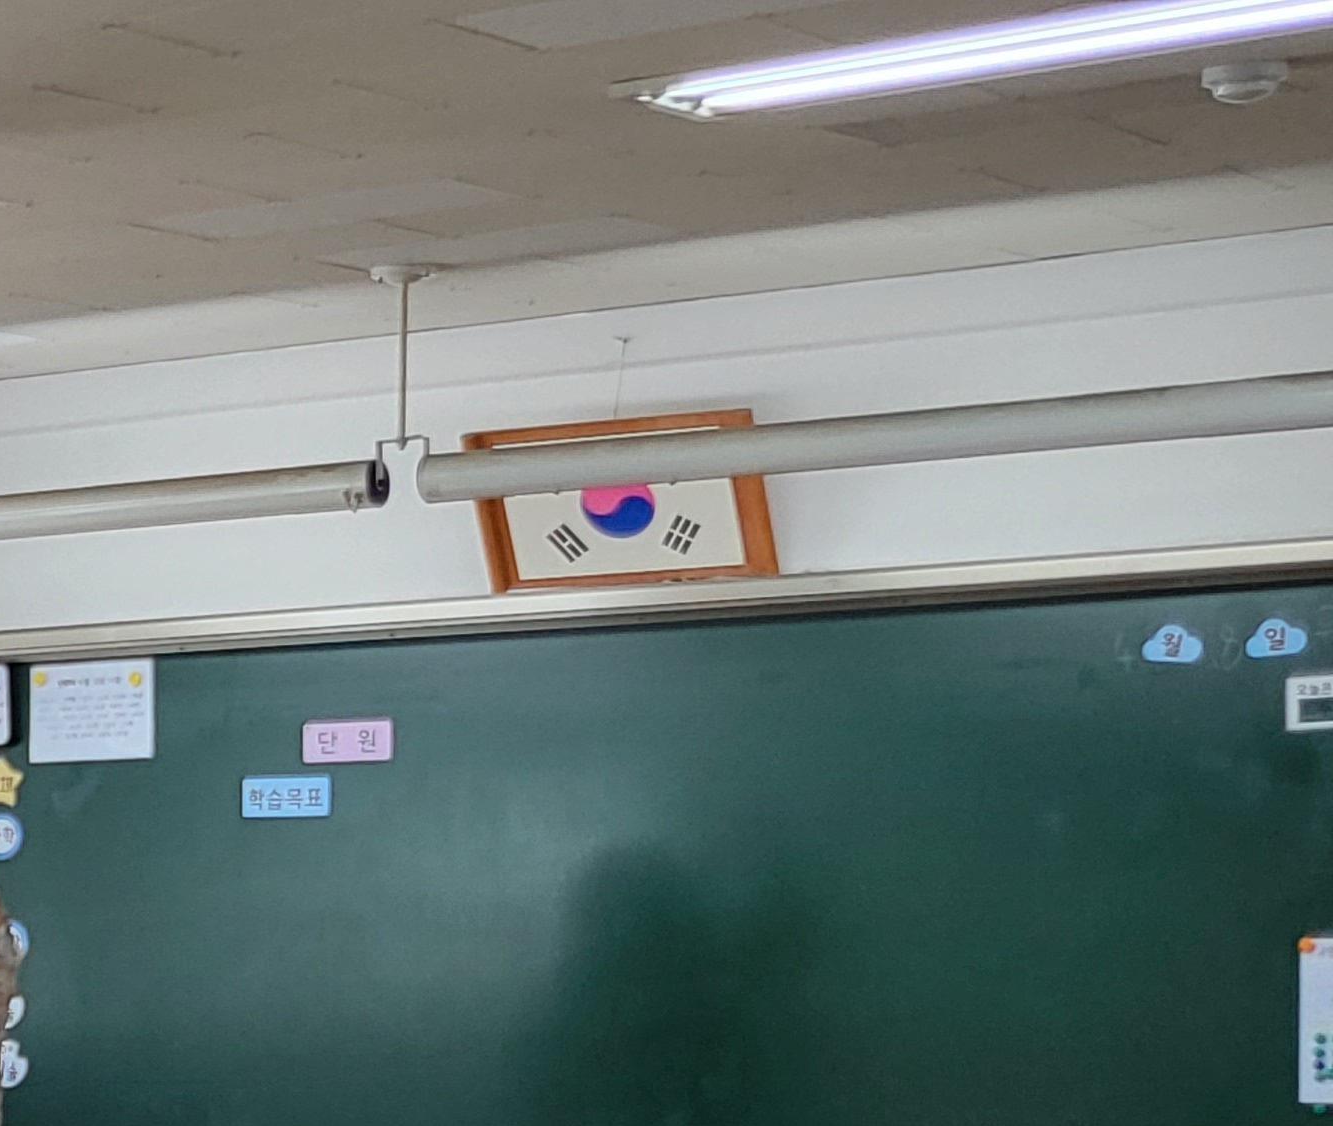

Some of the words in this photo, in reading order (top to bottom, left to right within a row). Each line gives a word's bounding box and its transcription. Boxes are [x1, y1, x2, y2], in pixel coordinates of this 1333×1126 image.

[1161, 632, 1183, 658] 월
[1263, 627, 1286, 652] 일
[247, 786, 324, 811] 학습목표
